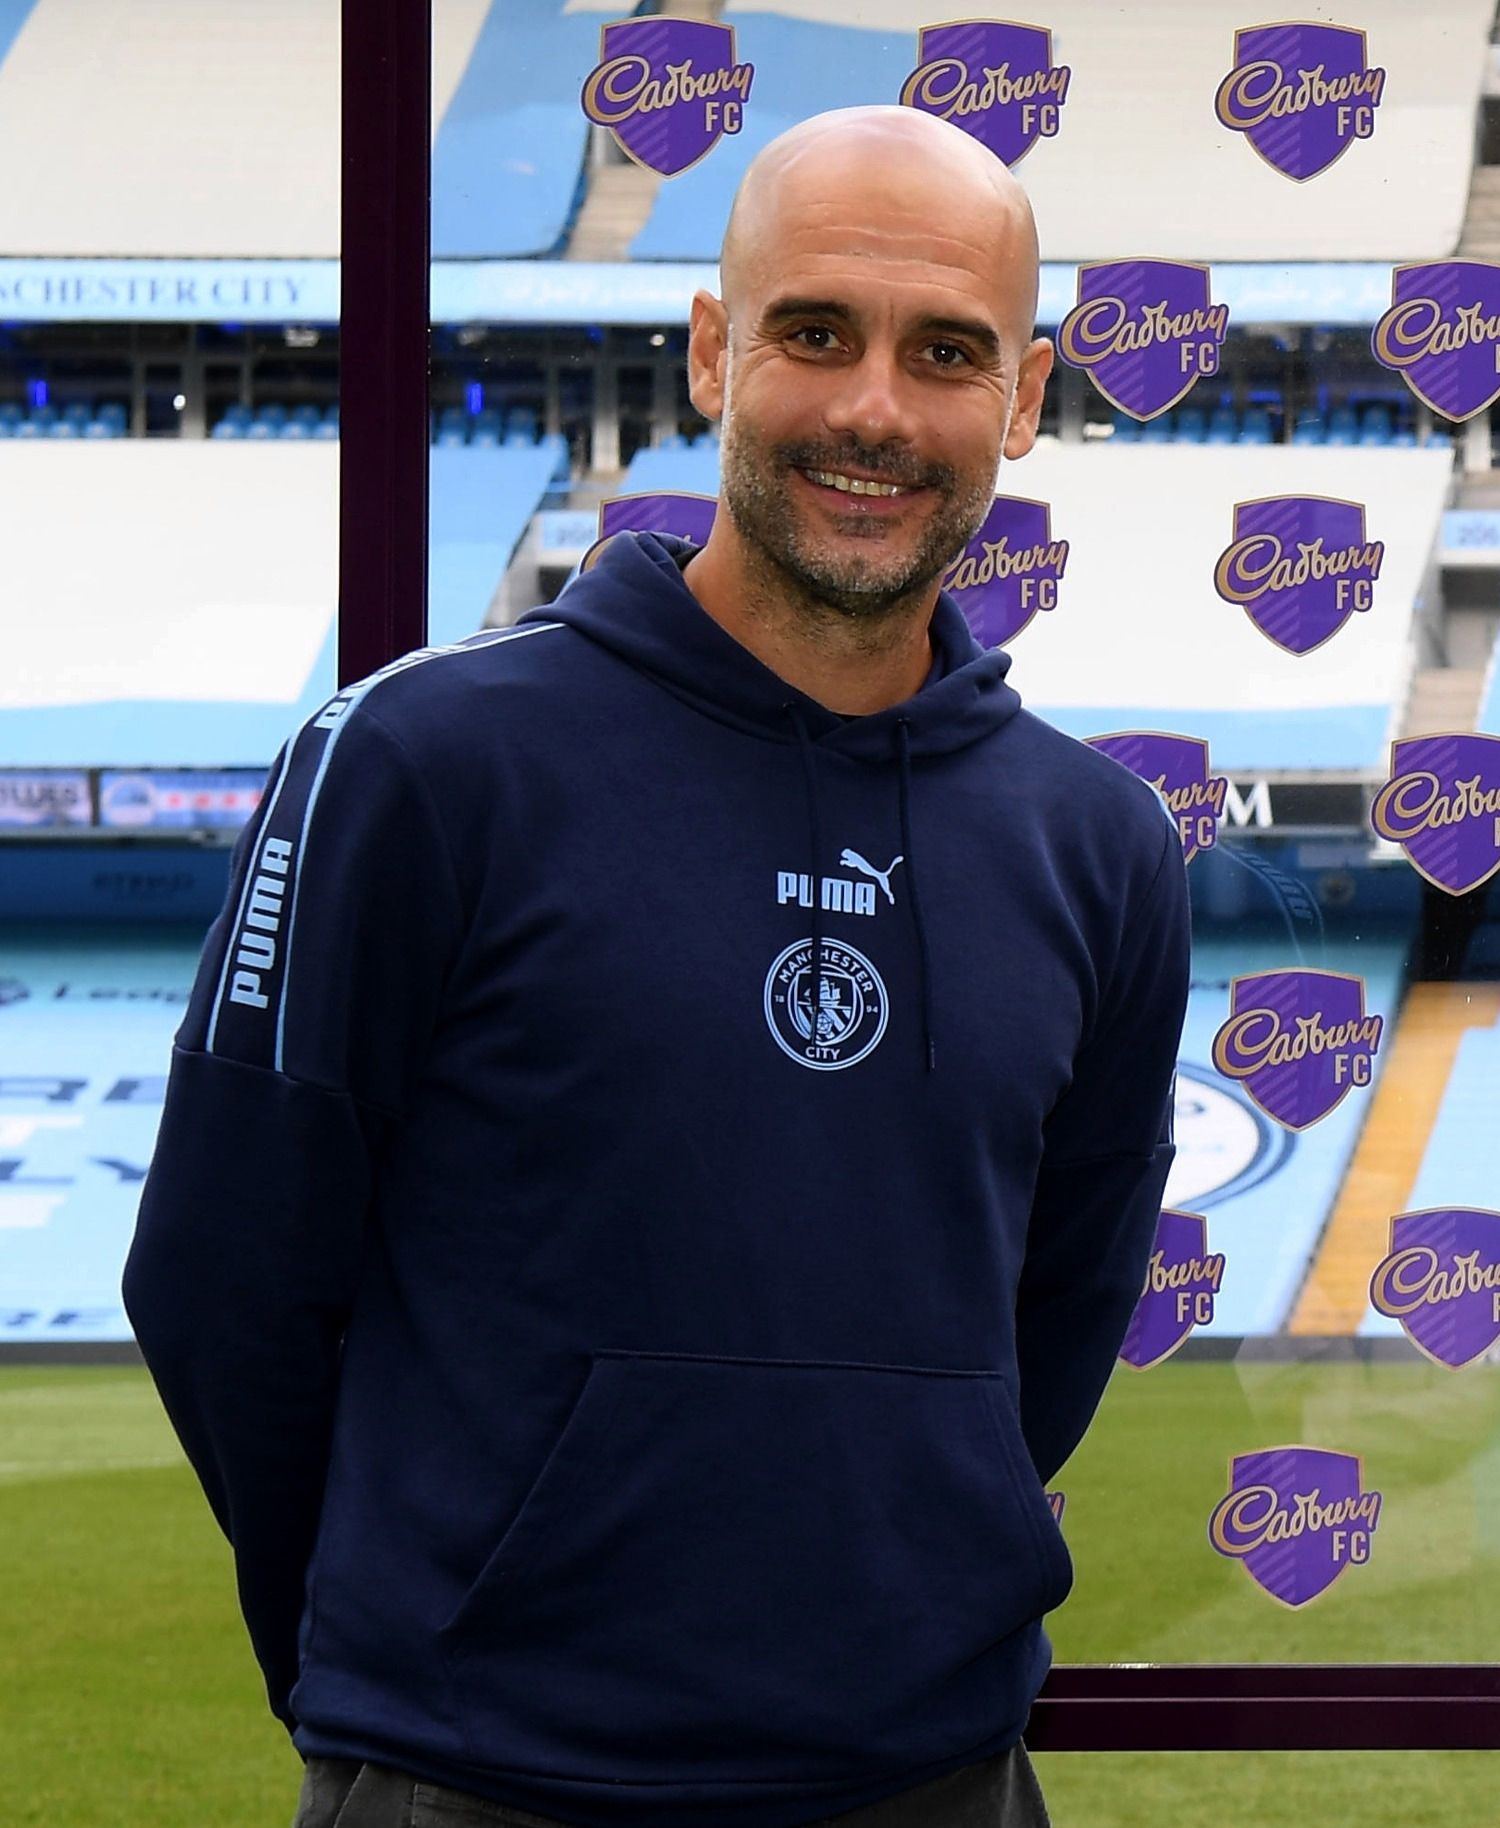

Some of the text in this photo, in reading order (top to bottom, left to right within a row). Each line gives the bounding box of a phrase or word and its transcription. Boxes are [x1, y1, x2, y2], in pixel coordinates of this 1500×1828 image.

[586, 56, 751, 123] Cadbury
[903, 59, 1066, 120] Cadbury
[1218, 61, 1383, 128] Cadbury
[705, 101, 739, 132] FC
[1022, 104, 1056, 135] FC
[1337, 106, 1371, 137] FC
[211, 278, 305, 303] CITY
[1061, 297, 1226, 364] Cadbury
[1180, 342, 1214, 373] FC
[1217, 534, 1382, 601] Cadbury
[1021, 578, 1054, 609] FC
[1336, 579, 1370, 610] FC
[1179, 816, 1213, 847] FC
[777, 871, 876, 916] PUMA
[229, 837, 293, 1009] PUMA
[805, 1046, 840, 1061] CITY
[1215, 1009, 1380, 1076] Cadbury
[1334, 1054, 1368, 1085] FC
[1143, 1250, 1222, 1295] bury
[1177, 1292, 1211, 1322] FC
[1213, 1486, 1378, 1553] Cadbury
[1332, 1531, 1366, 1562] FC
